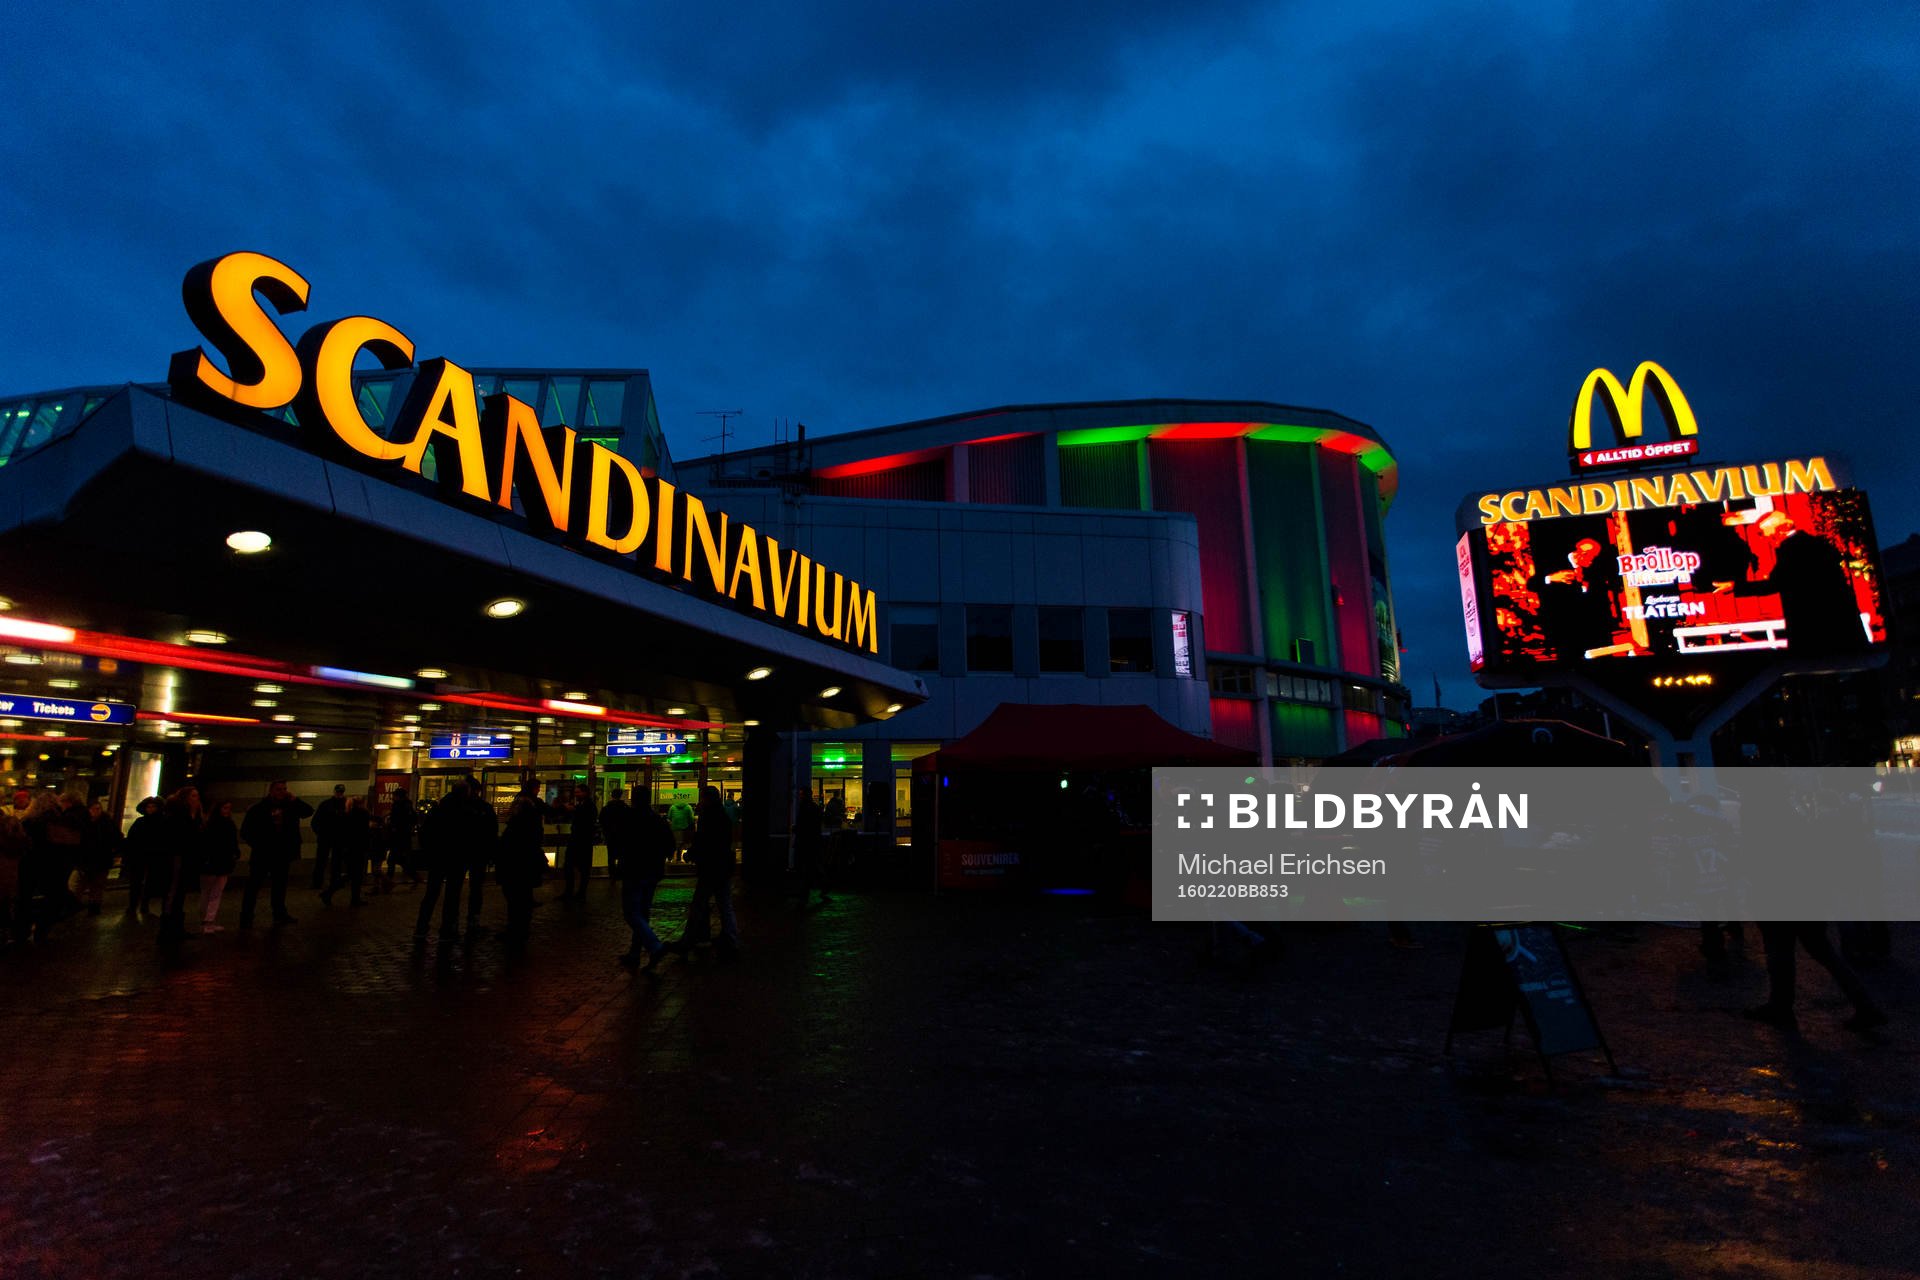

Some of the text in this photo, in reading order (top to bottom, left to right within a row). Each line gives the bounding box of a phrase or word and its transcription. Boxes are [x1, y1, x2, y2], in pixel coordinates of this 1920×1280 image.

[188, 250, 879, 654] SCANDINAVIUM
[1596, 441, 1691, 463] ALLTID ÖPPET
[1478, 457, 1837, 526] SCANDINAVIUM
[1616, 545, 1700, 576] Bröllop
[1622, 601, 1706, 619] TEATERN
[32, 701, 76, 716] Tickets
